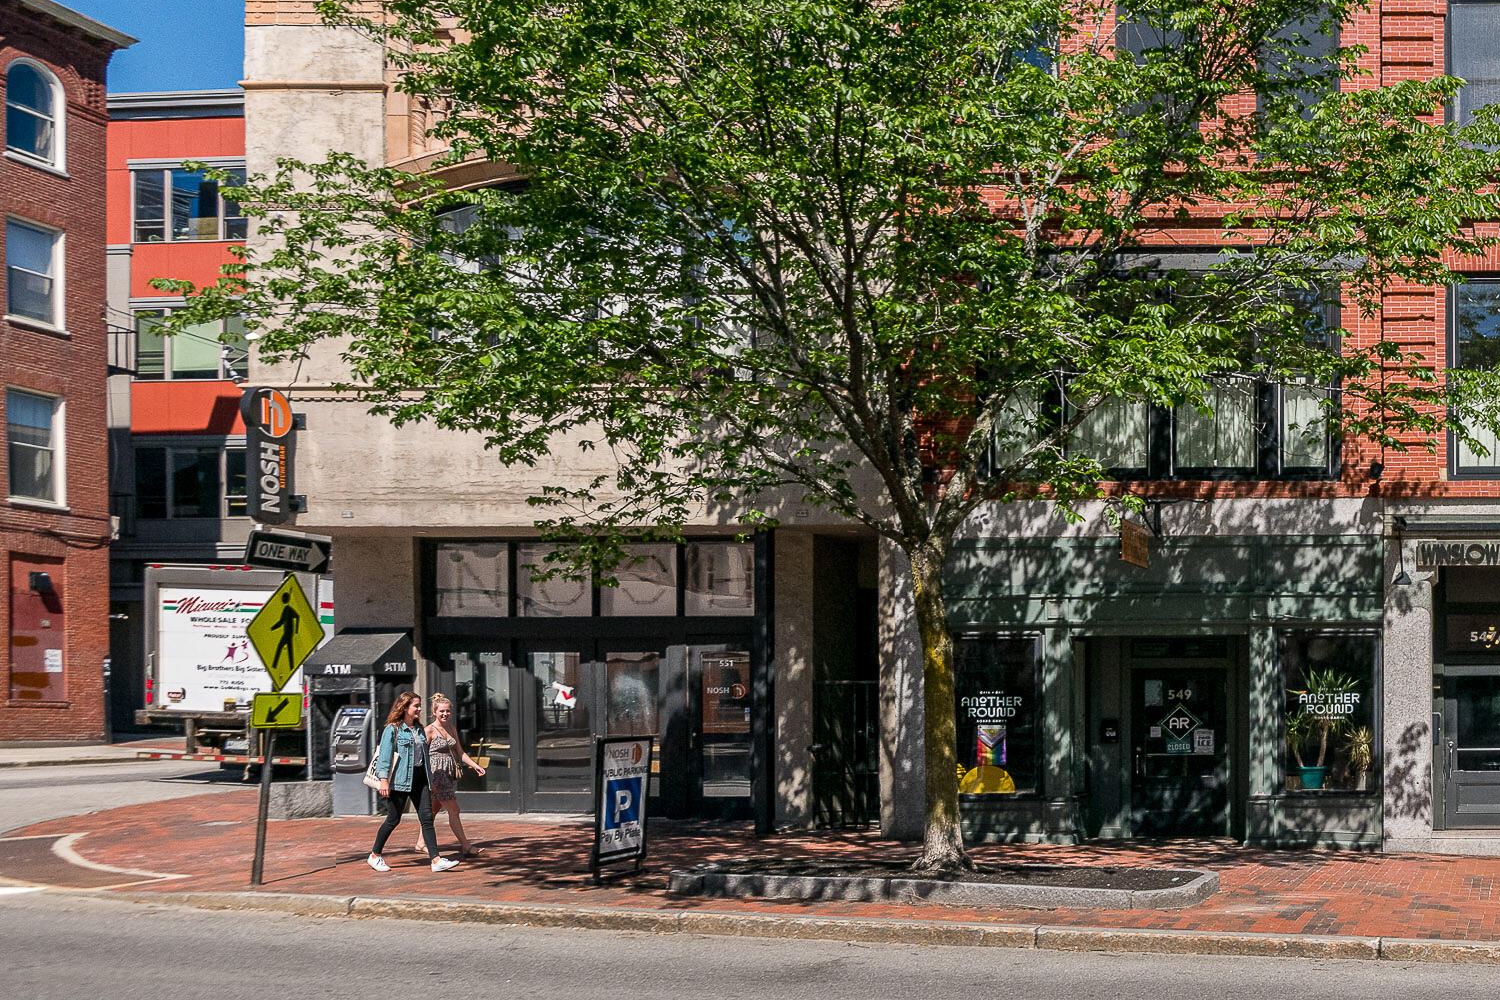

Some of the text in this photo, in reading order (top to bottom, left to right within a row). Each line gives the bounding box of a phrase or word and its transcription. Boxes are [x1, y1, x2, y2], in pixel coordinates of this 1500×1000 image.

[260, 441, 281, 513] NOSH
[258, 542, 311, 562] ONE WAY
[1420, 543, 1500, 565] WINSLOW
[324, 664, 351, 674] ATM
[384, 662, 406, 672] ATM
[706, 686, 730, 694] NOSH
[1167, 689, 1192, 700] 549
[967, 707, 1016, 718] ROUND
[1306, 703, 1354, 714] ROUND
[1169, 717, 1190, 729] AR
[1167, 742, 1191, 751] CLOSED
[608, 748, 629, 759] NOSH
[614, 789, 632, 824] P
[601, 832, 613, 845] Pay
[615, 829, 624, 842] By
